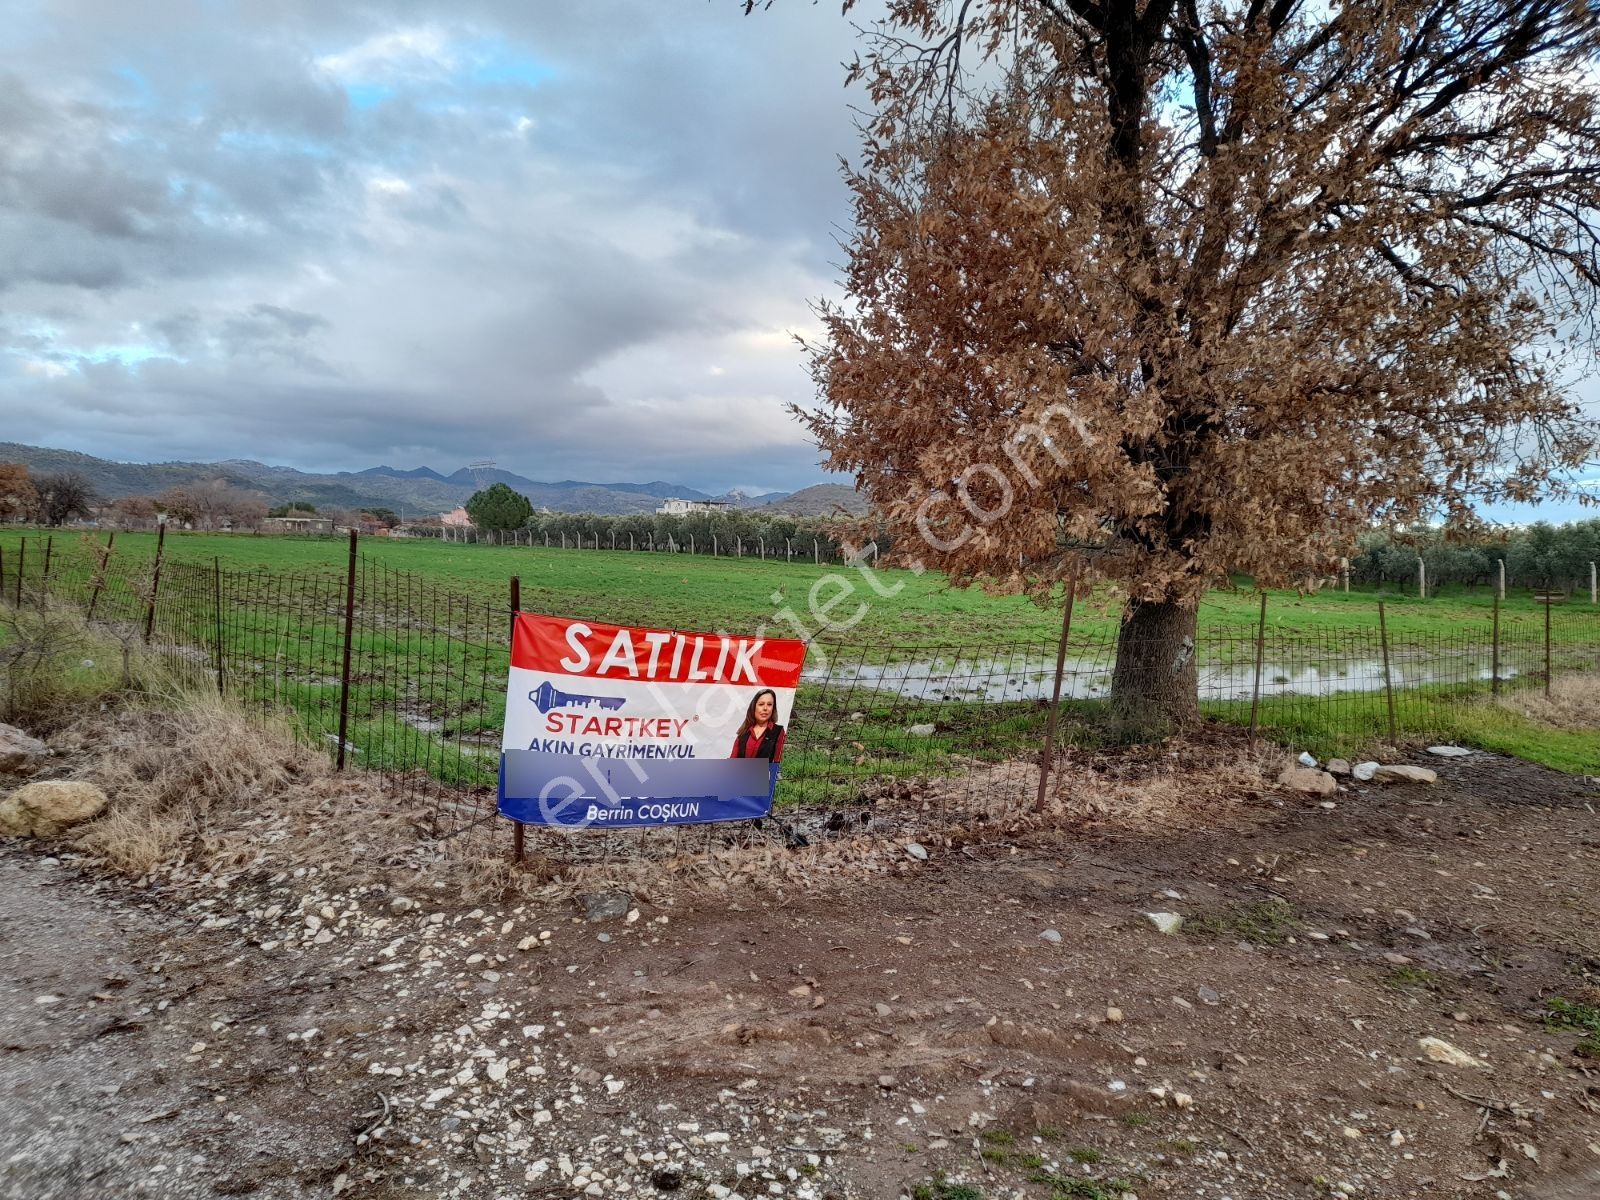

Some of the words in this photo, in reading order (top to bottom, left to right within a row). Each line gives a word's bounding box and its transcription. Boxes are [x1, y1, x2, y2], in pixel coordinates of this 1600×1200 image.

[560, 623, 765, 682] SATILIK
[528, 738, 574, 755] AKIN
[579, 740, 696, 759] GAYRİMENKUL
[587, 804, 633, 820] Berrin
[638, 802, 700, 822] COŞKUN
